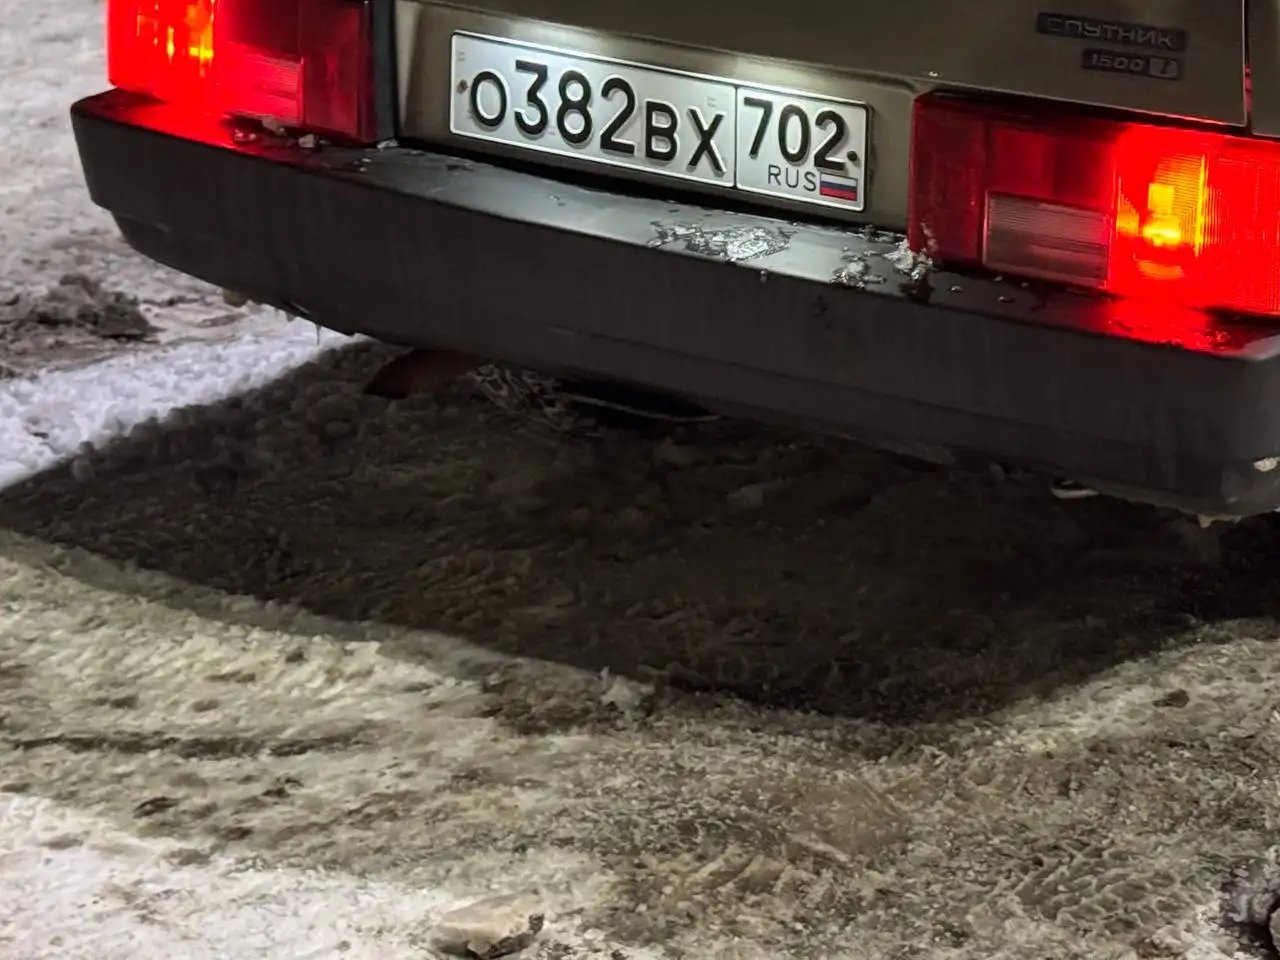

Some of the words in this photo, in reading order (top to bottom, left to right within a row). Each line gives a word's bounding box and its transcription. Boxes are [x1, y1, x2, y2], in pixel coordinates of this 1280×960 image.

[1048, 18, 1173, 47] СПУТНИК
[1090, 53, 1145, 73] 1500
[744, 98, 847, 170] 702
[768, 165, 816, 191] RUS
